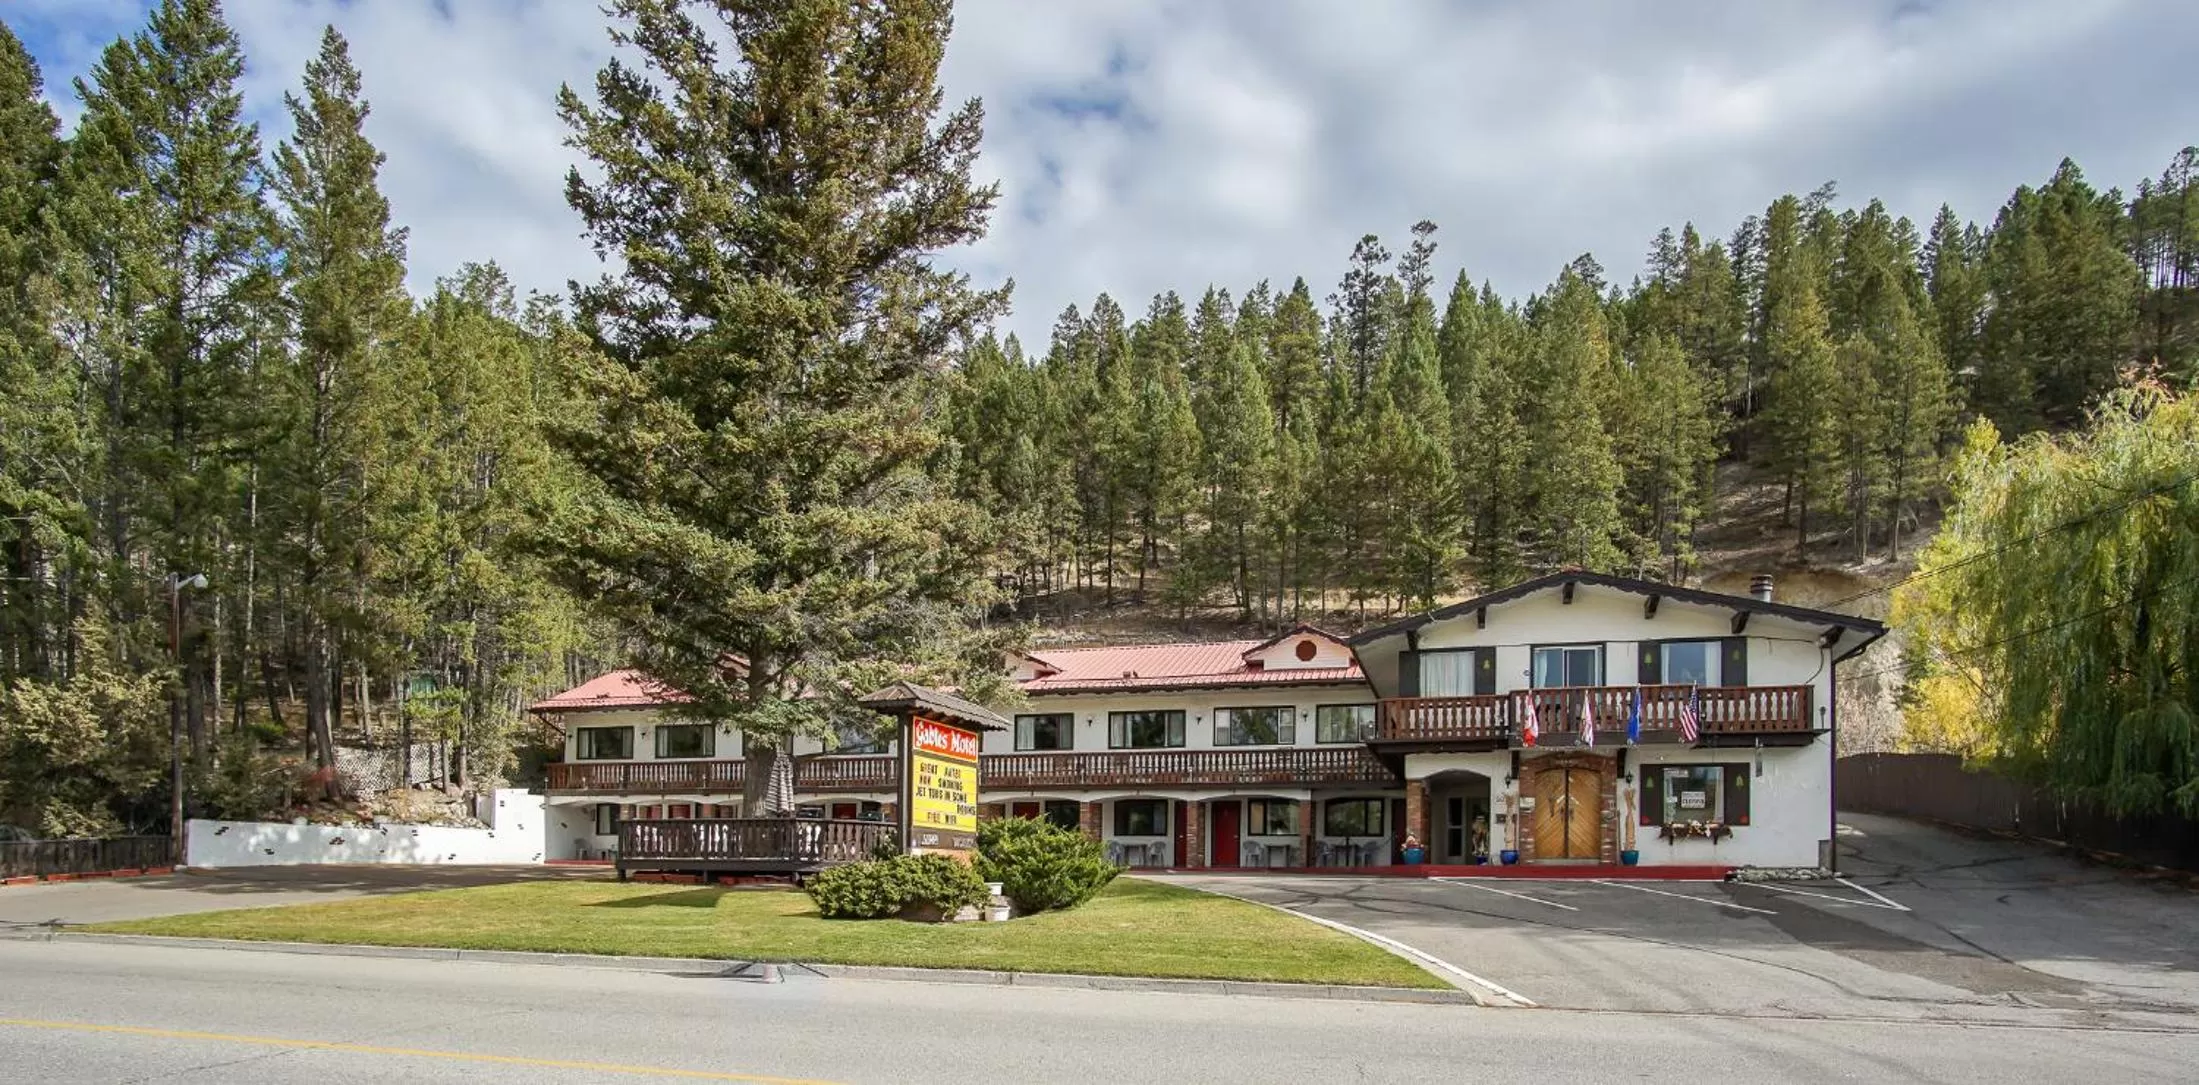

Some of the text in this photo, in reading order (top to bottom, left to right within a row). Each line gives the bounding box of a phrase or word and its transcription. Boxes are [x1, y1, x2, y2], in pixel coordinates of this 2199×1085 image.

[916, 721, 976, 756] Gables Motel
[920, 762, 961, 779] GREAT RATES
[938, 778, 963, 791] SMOKING
[916, 786, 967, 803] JET TUBS IN SOME
[956, 804, 976, 815] ROOMS
